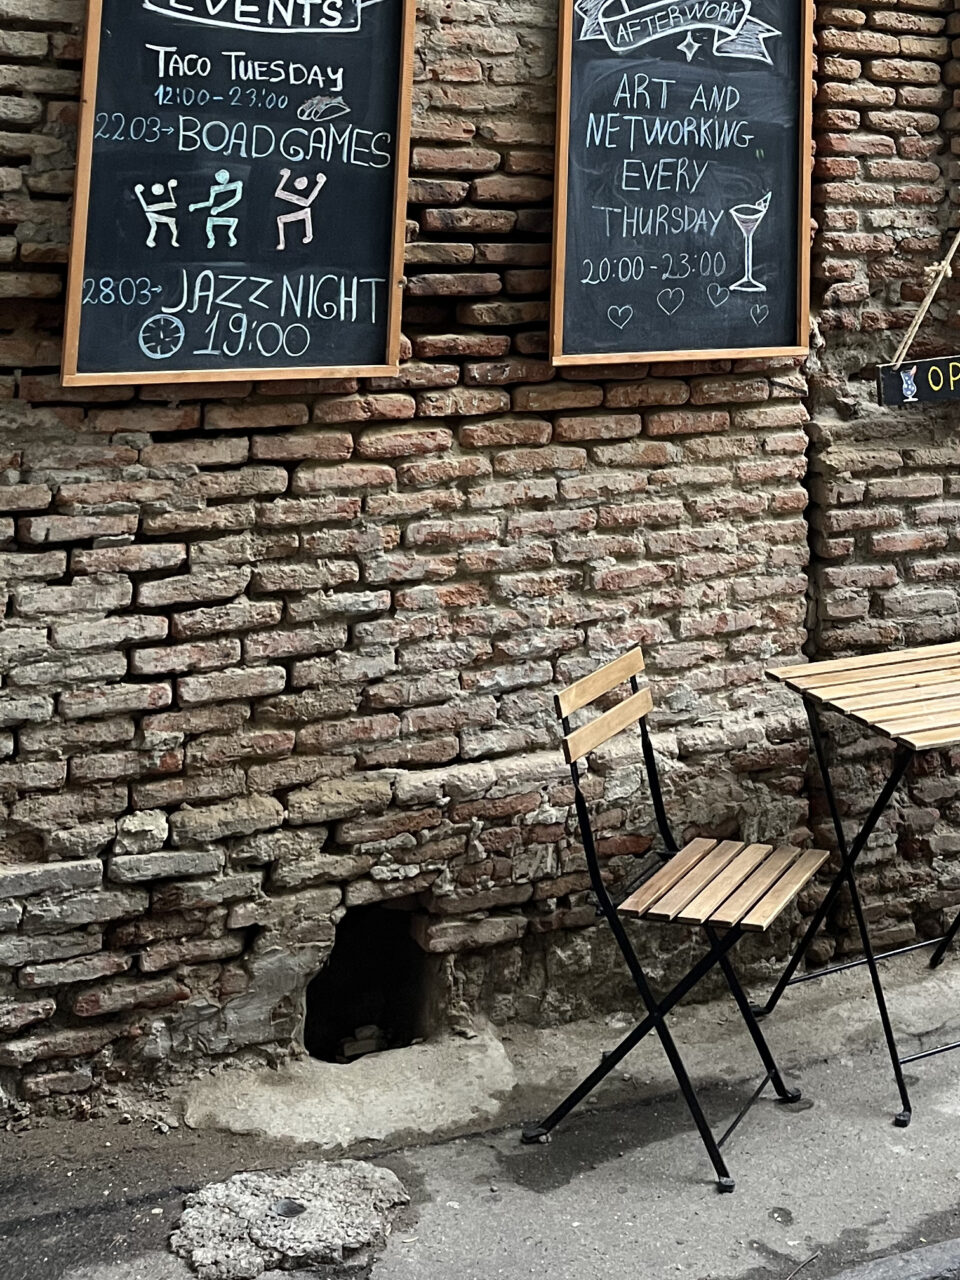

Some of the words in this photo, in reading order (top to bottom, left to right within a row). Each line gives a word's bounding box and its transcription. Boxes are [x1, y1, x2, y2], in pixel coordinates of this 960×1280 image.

[145, 43, 212, 79] TACO
[221, 51, 344, 92] TUESDAY
[613, 72, 677, 110] ART
[689, 84, 741, 113] AND
[586, 112, 755, 152] NETWORKING
[621, 156, 710, 194] EVERY
[591, 204, 725, 238] THURSDAY
[161, 268, 275, 315] JAZZ
[280, 274, 387, 324] NIGHT
[192, 310, 311, 357] 19:00
